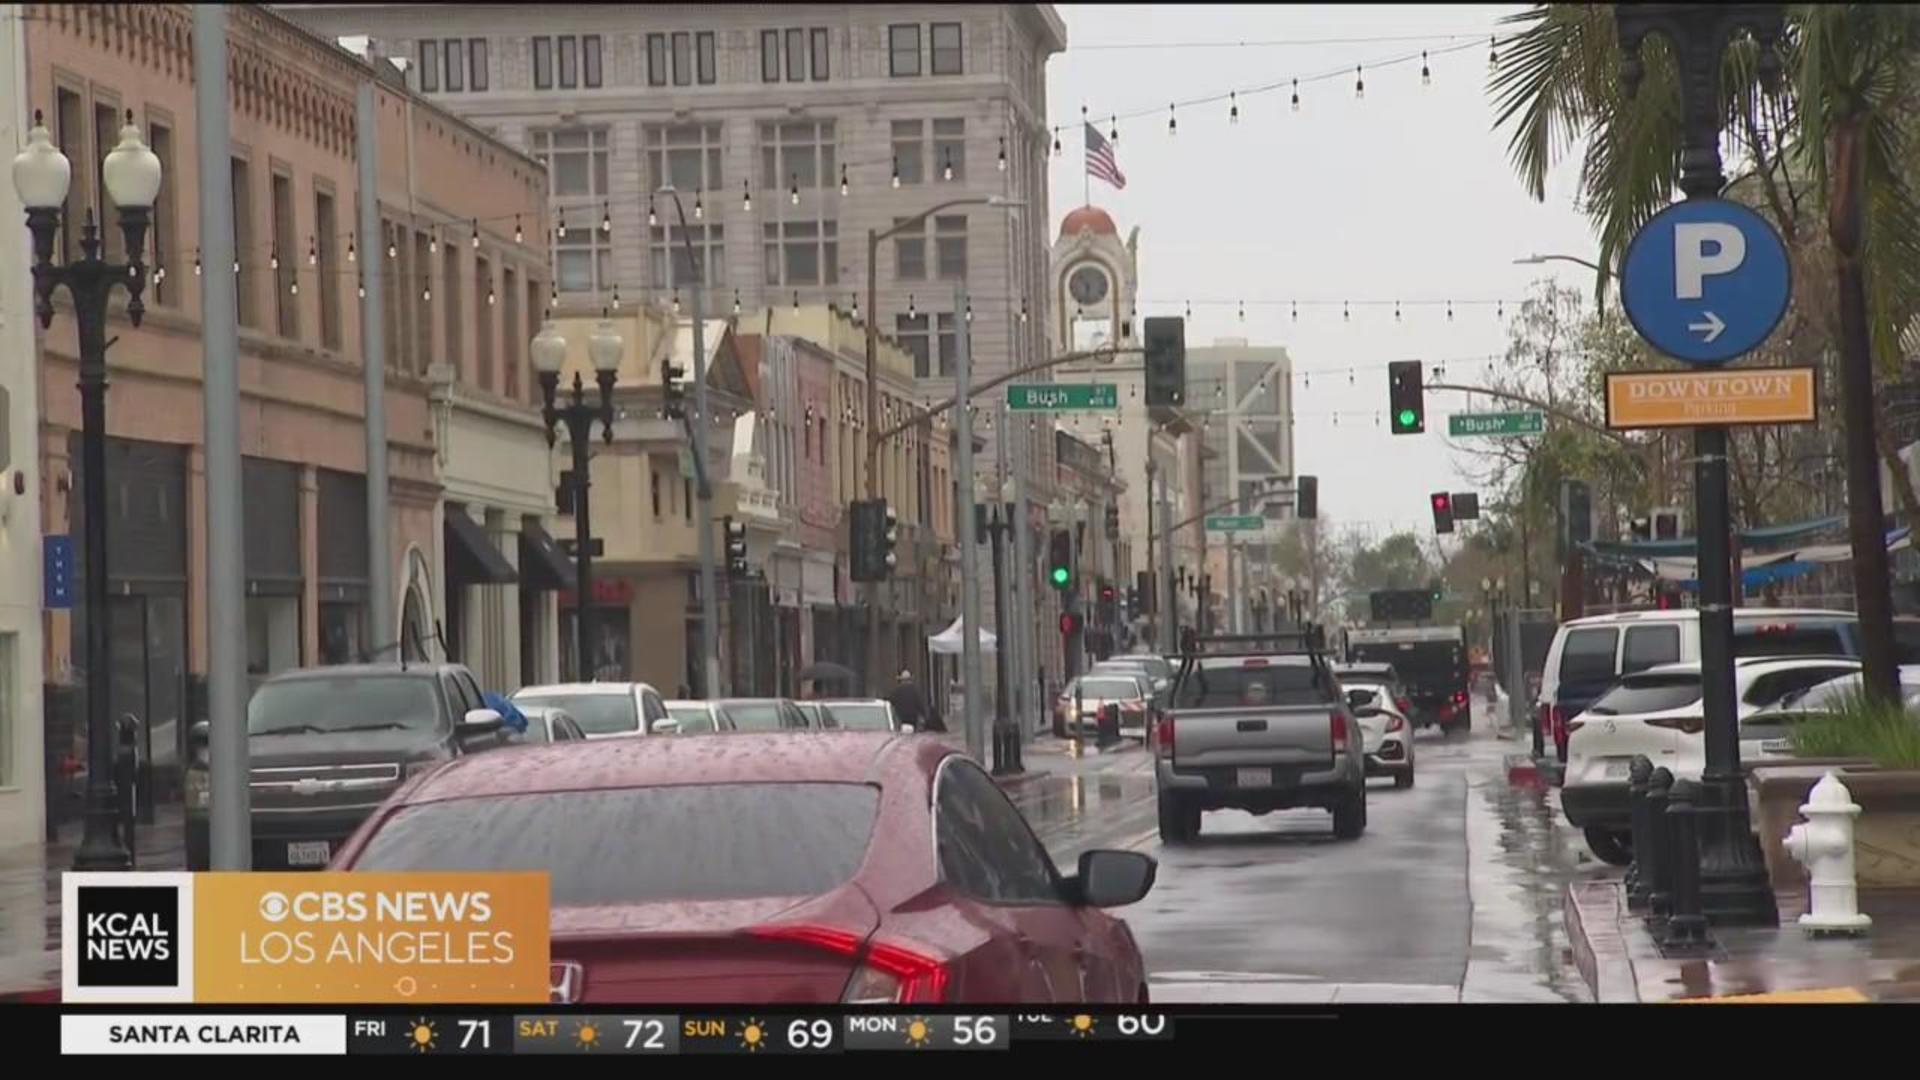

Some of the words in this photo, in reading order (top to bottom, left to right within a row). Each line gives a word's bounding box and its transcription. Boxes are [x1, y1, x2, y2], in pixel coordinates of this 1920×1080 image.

[1674, 222, 1746, 299] P
[1630, 377, 1792, 398] DOWNTOWN
[1026, 389, 1069, 405] Bush
[1466, 417, 1502, 432] Bush
